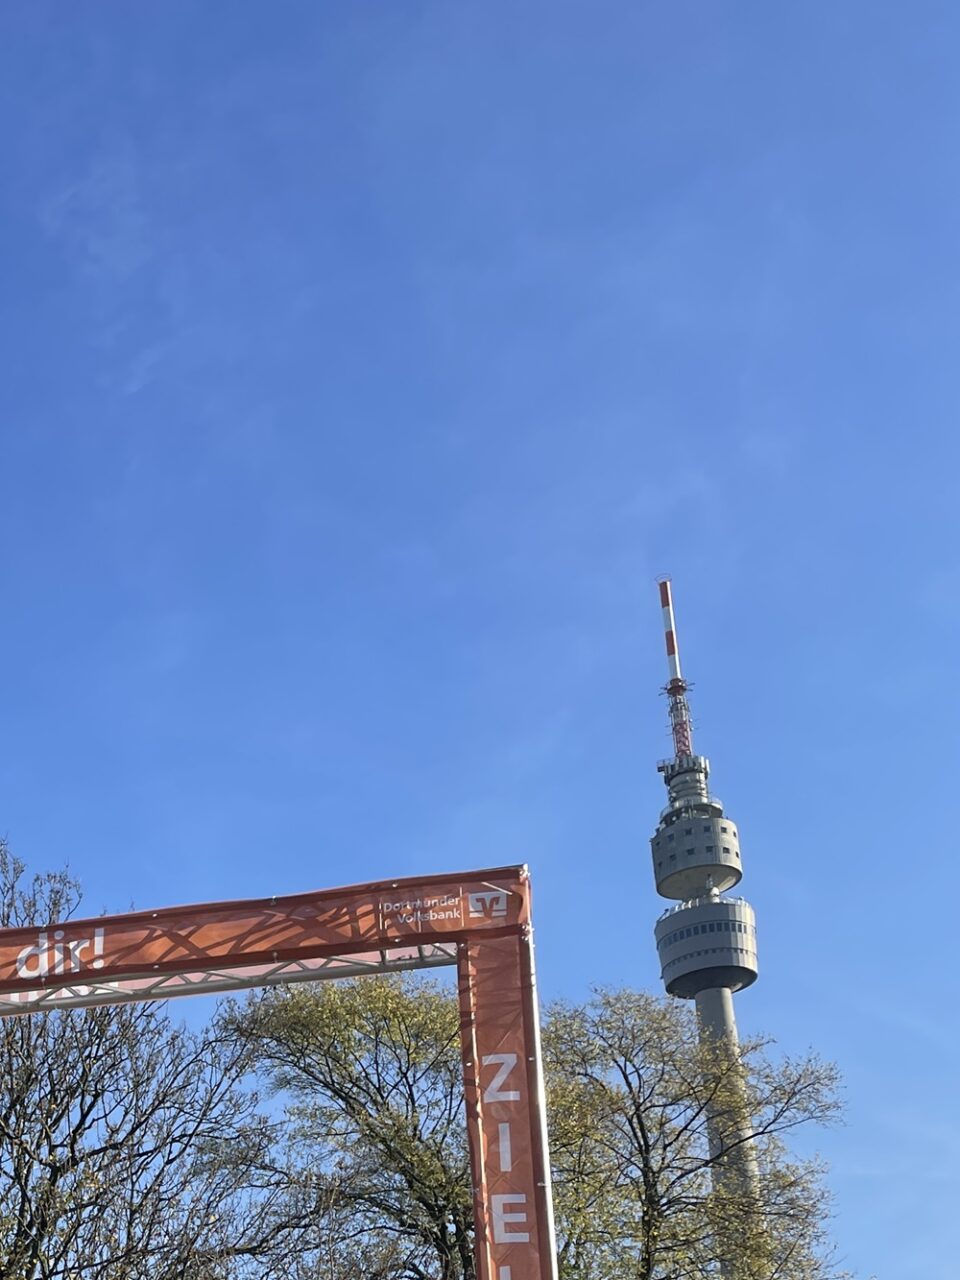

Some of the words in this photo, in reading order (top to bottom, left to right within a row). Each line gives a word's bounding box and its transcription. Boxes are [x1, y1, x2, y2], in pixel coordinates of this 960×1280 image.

[383, 895, 461, 913] Dortmunder
[397, 908, 461, 924] Volksbank
[18, 928, 105, 979] dir!
